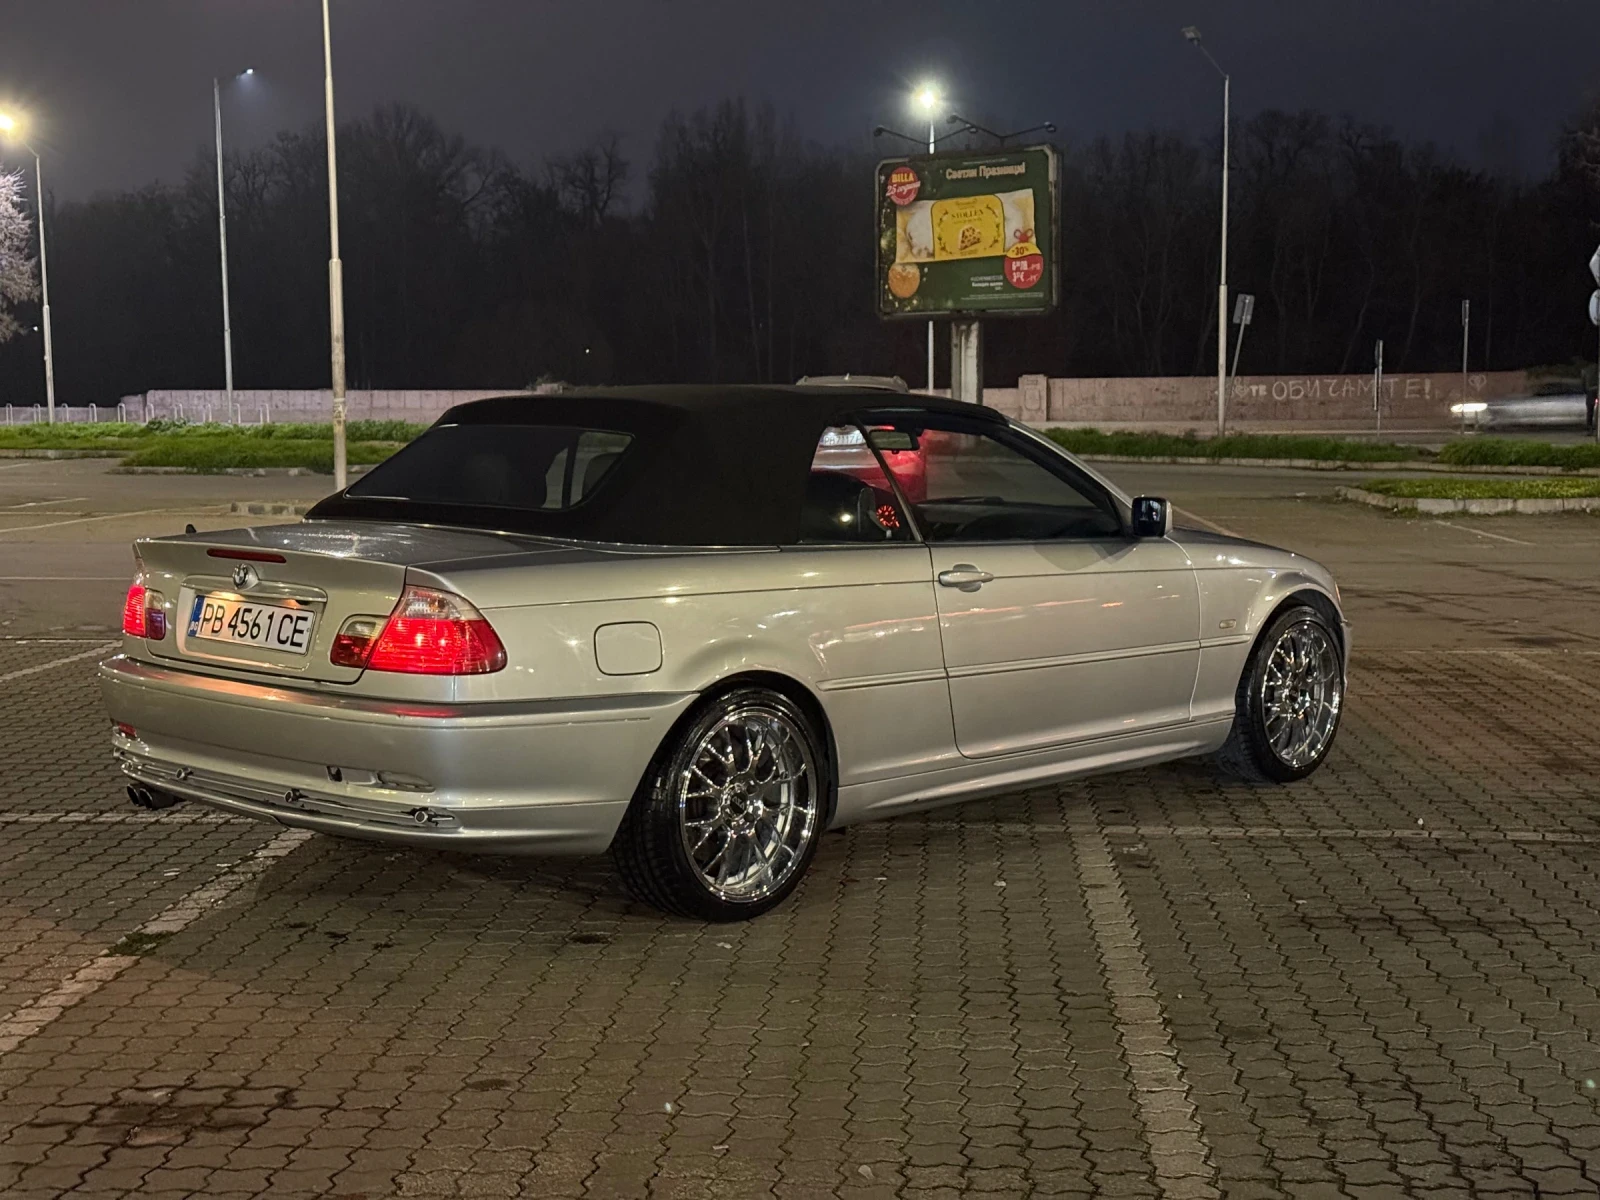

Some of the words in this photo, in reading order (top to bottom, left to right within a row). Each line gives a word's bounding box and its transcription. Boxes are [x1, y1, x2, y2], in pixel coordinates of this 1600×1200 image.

[891, 173, 914, 183] BILLA
[200, 603, 226, 634] PB
[228, 606, 275, 642] 4561
[277, 613, 308, 648] CE
